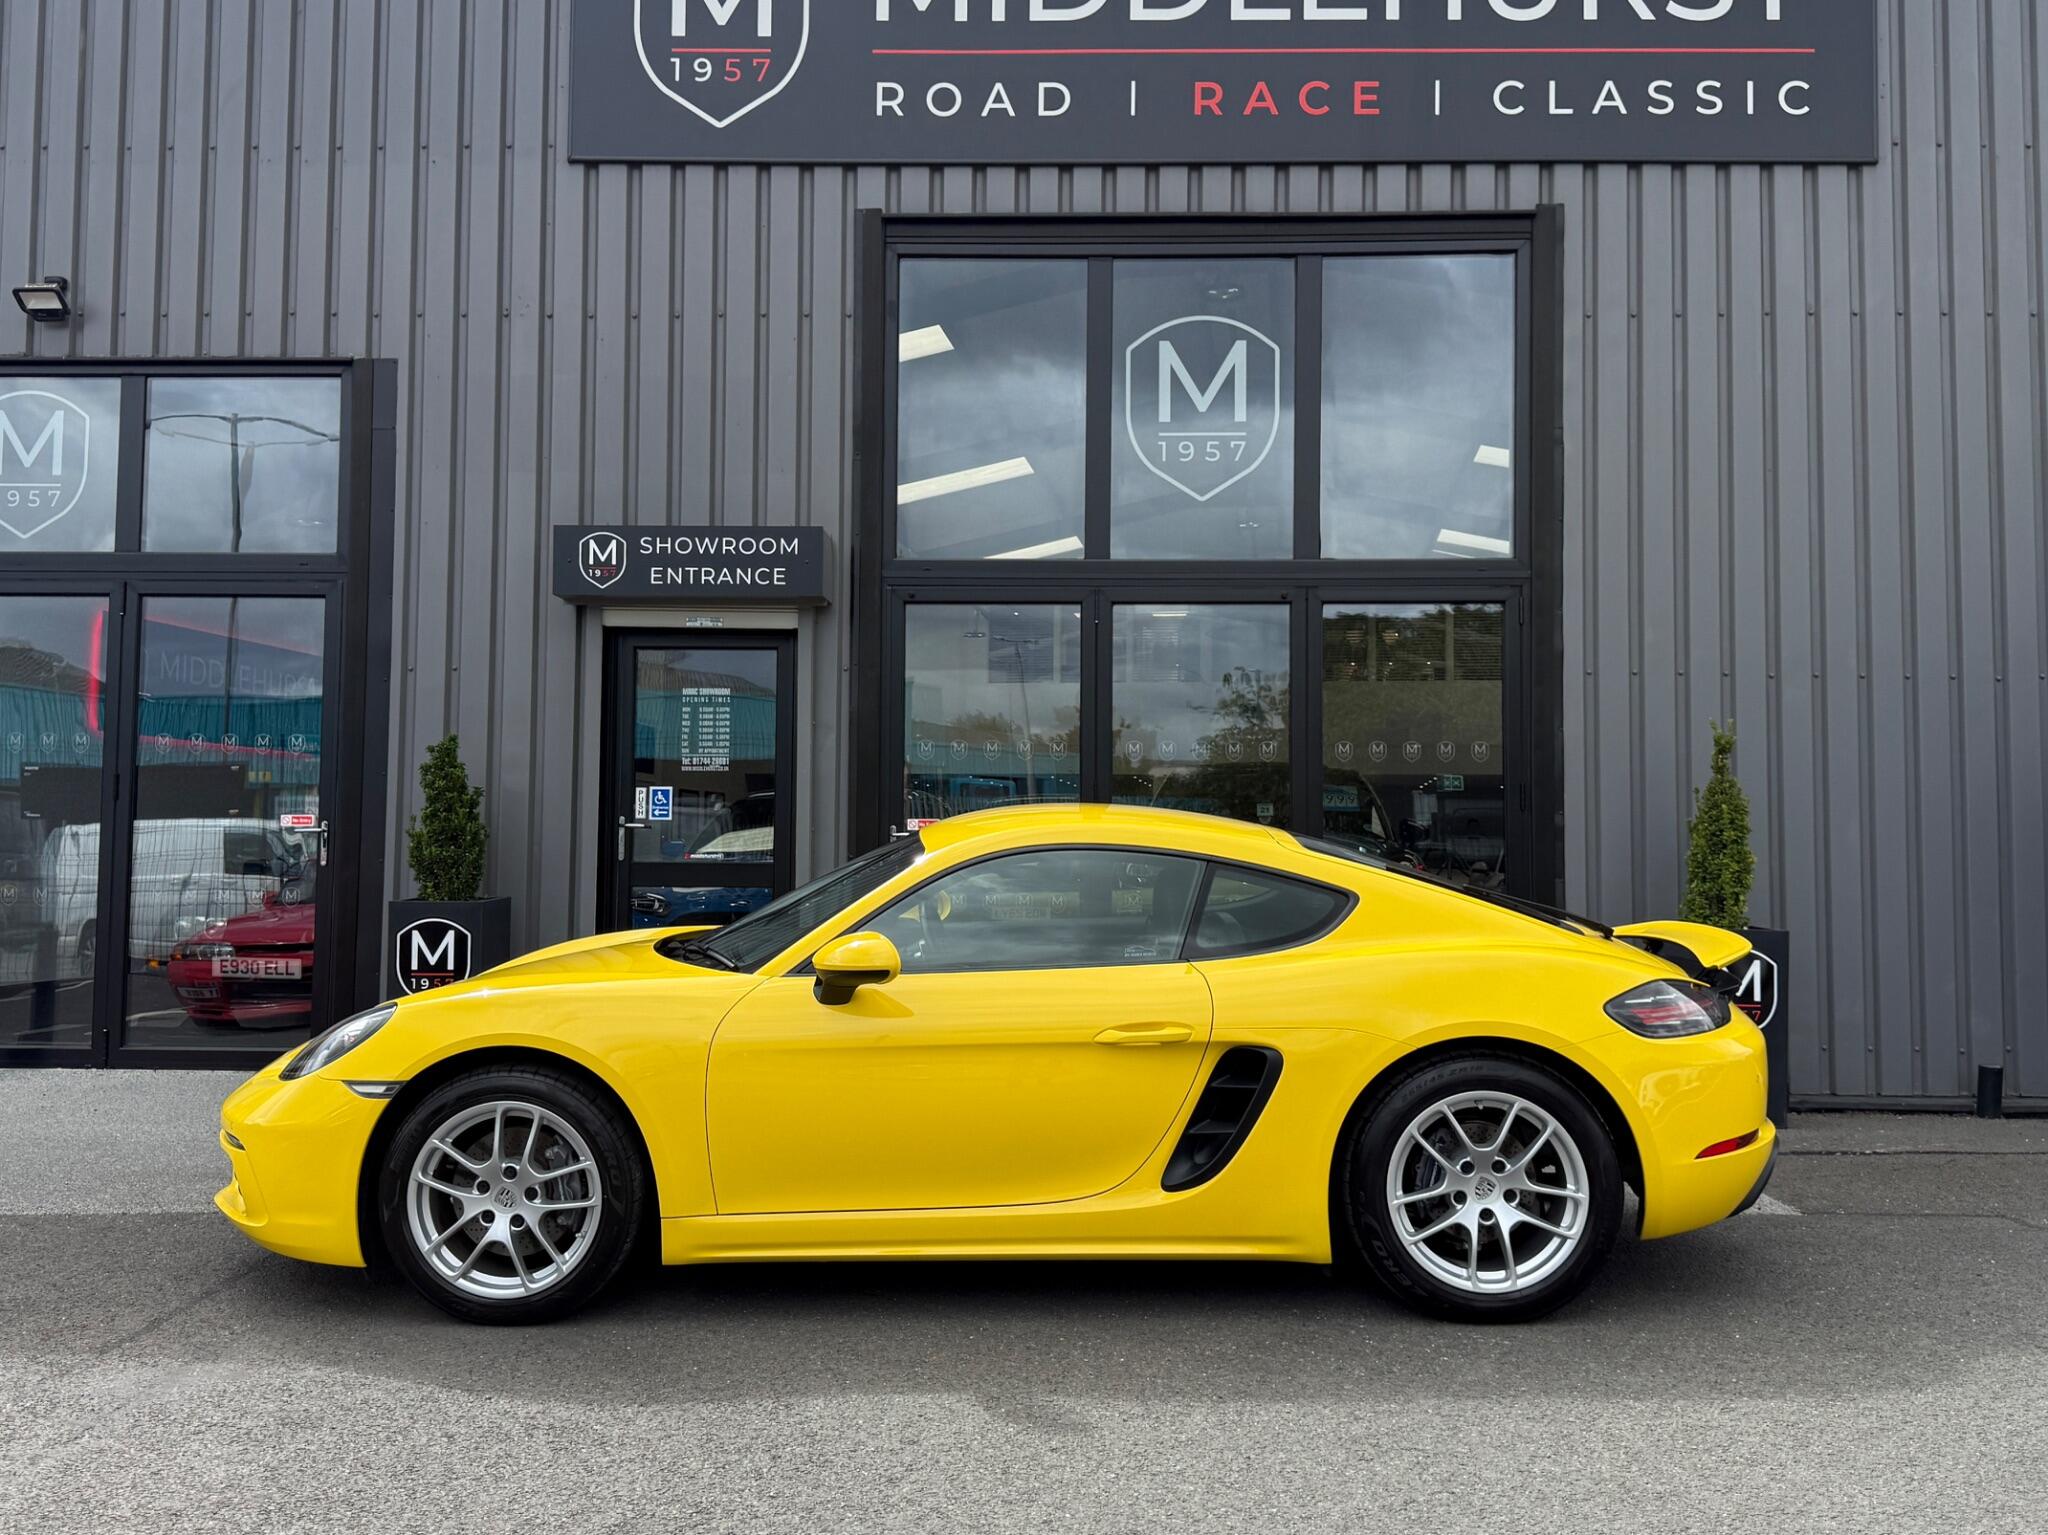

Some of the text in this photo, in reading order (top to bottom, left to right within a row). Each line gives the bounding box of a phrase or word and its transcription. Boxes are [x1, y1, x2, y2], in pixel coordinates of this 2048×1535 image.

[671, 58, 769, 81] 1957
[877, 80, 1809, 116] ROAD RACE CLASSIC
[1158, 441, 1245, 461] 1957
[7, 490, 61, 507] 957
[640, 537, 798, 554] SHOWROOM
[651, 568, 785, 584] ENTRANCE
[219, 959, 295, 976] E930 ELL
